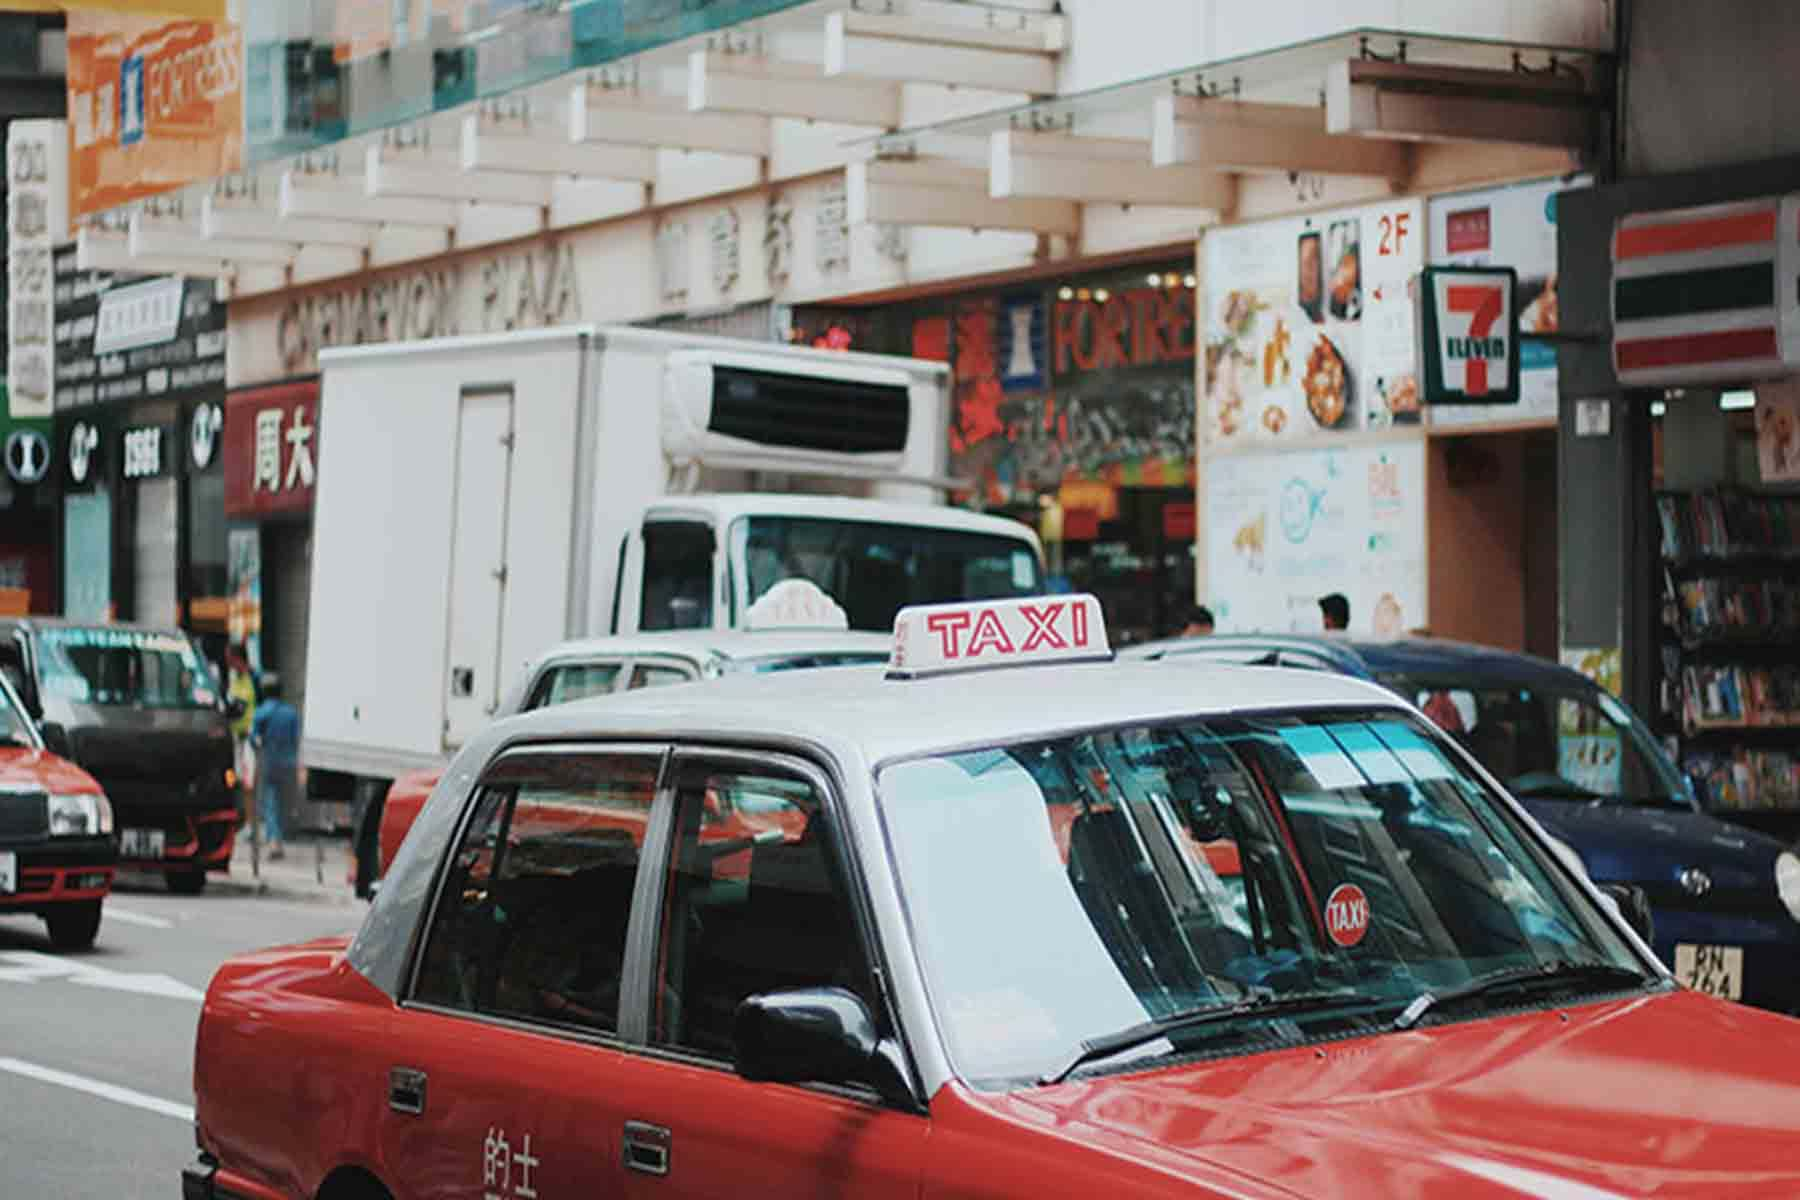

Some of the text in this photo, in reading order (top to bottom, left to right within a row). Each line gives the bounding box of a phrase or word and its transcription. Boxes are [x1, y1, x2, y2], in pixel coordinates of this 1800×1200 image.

[1378, 212, 1410, 257] 2F
[1446, 282, 1503, 395] 7
[928, 601, 1088, 659] TAXI
[1330, 898, 1365, 931] TAXI
[483, 1126, 540, 1198] 的士
